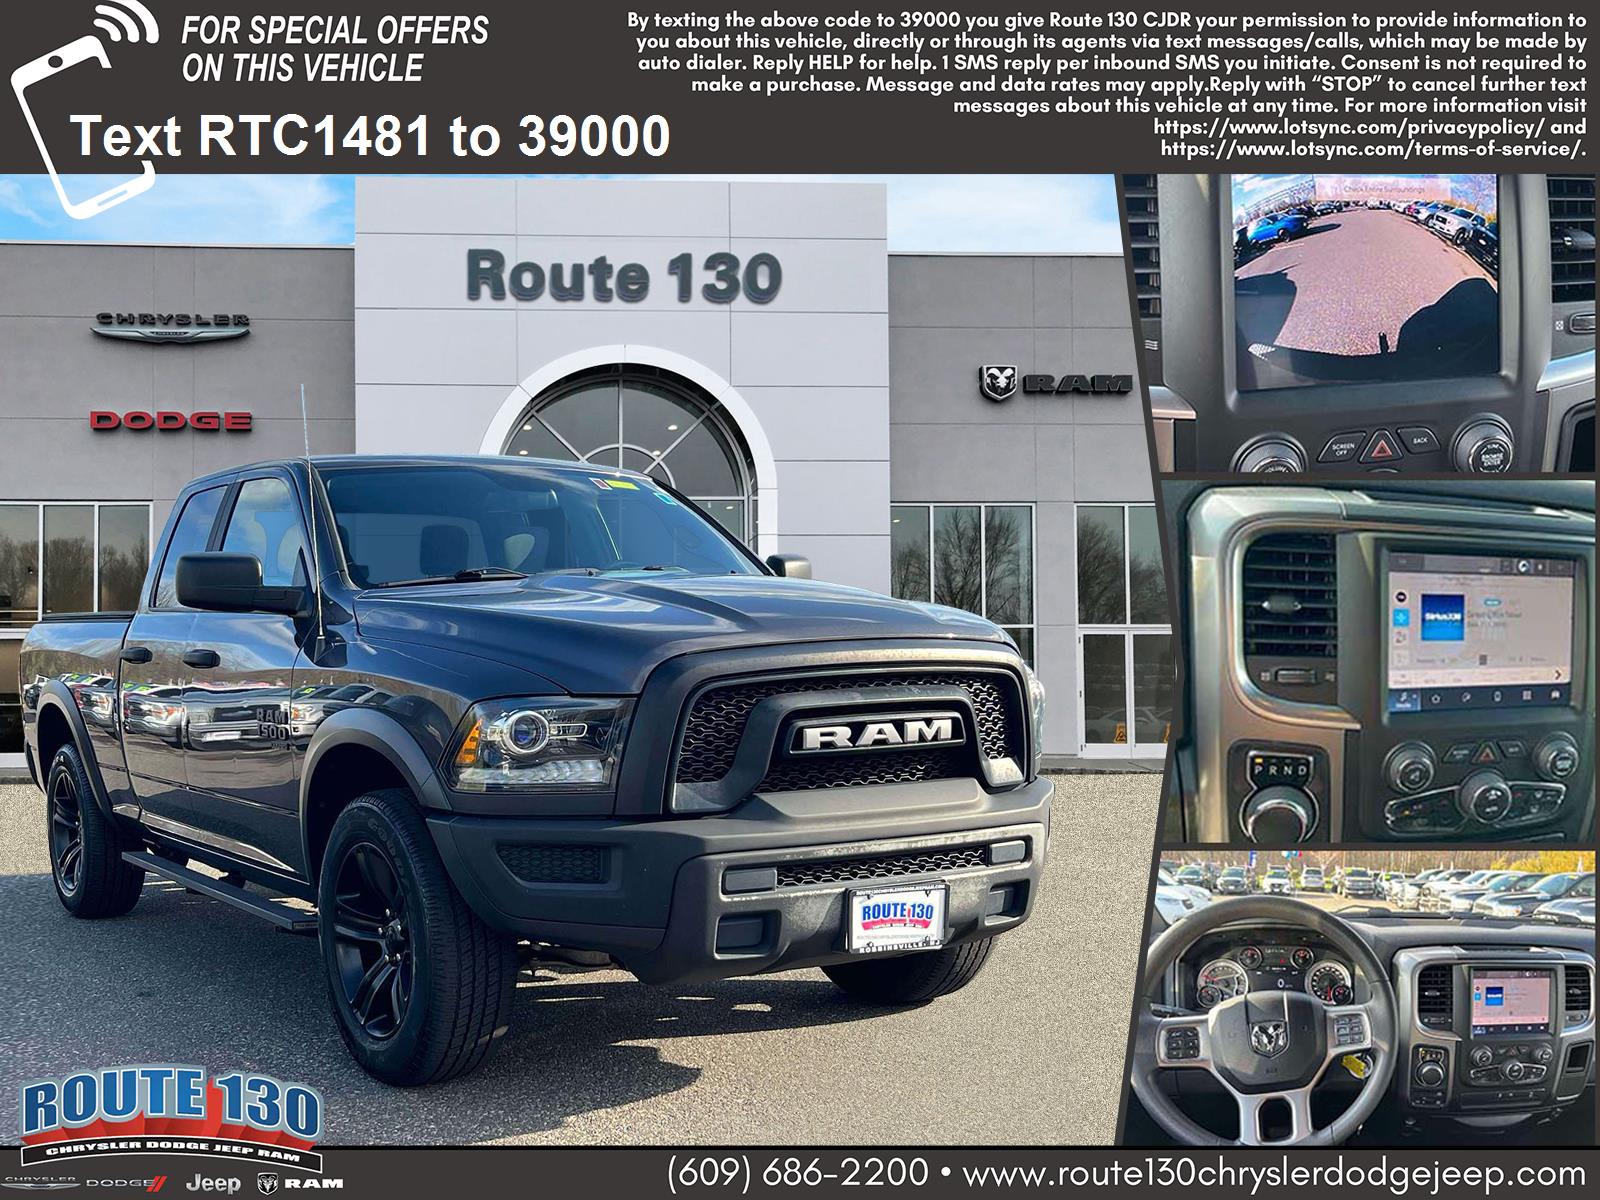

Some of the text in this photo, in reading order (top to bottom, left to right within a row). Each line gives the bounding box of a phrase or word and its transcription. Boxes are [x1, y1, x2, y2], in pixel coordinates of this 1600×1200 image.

[467, 249, 782, 305] Route 130
[96, 312, 250, 326] CHRYSLER
[1023, 374, 1133, 395] RAM
[89, 411, 252, 432] DODGE
[1332, 443, 1355, 451] SCREEN
[256, 708, 286, 724] RAM
[802, 718, 953, 751] RAM
[1254, 765, 1307, 775] P R N D
[863, 903, 934, 921] ROUTE 130
